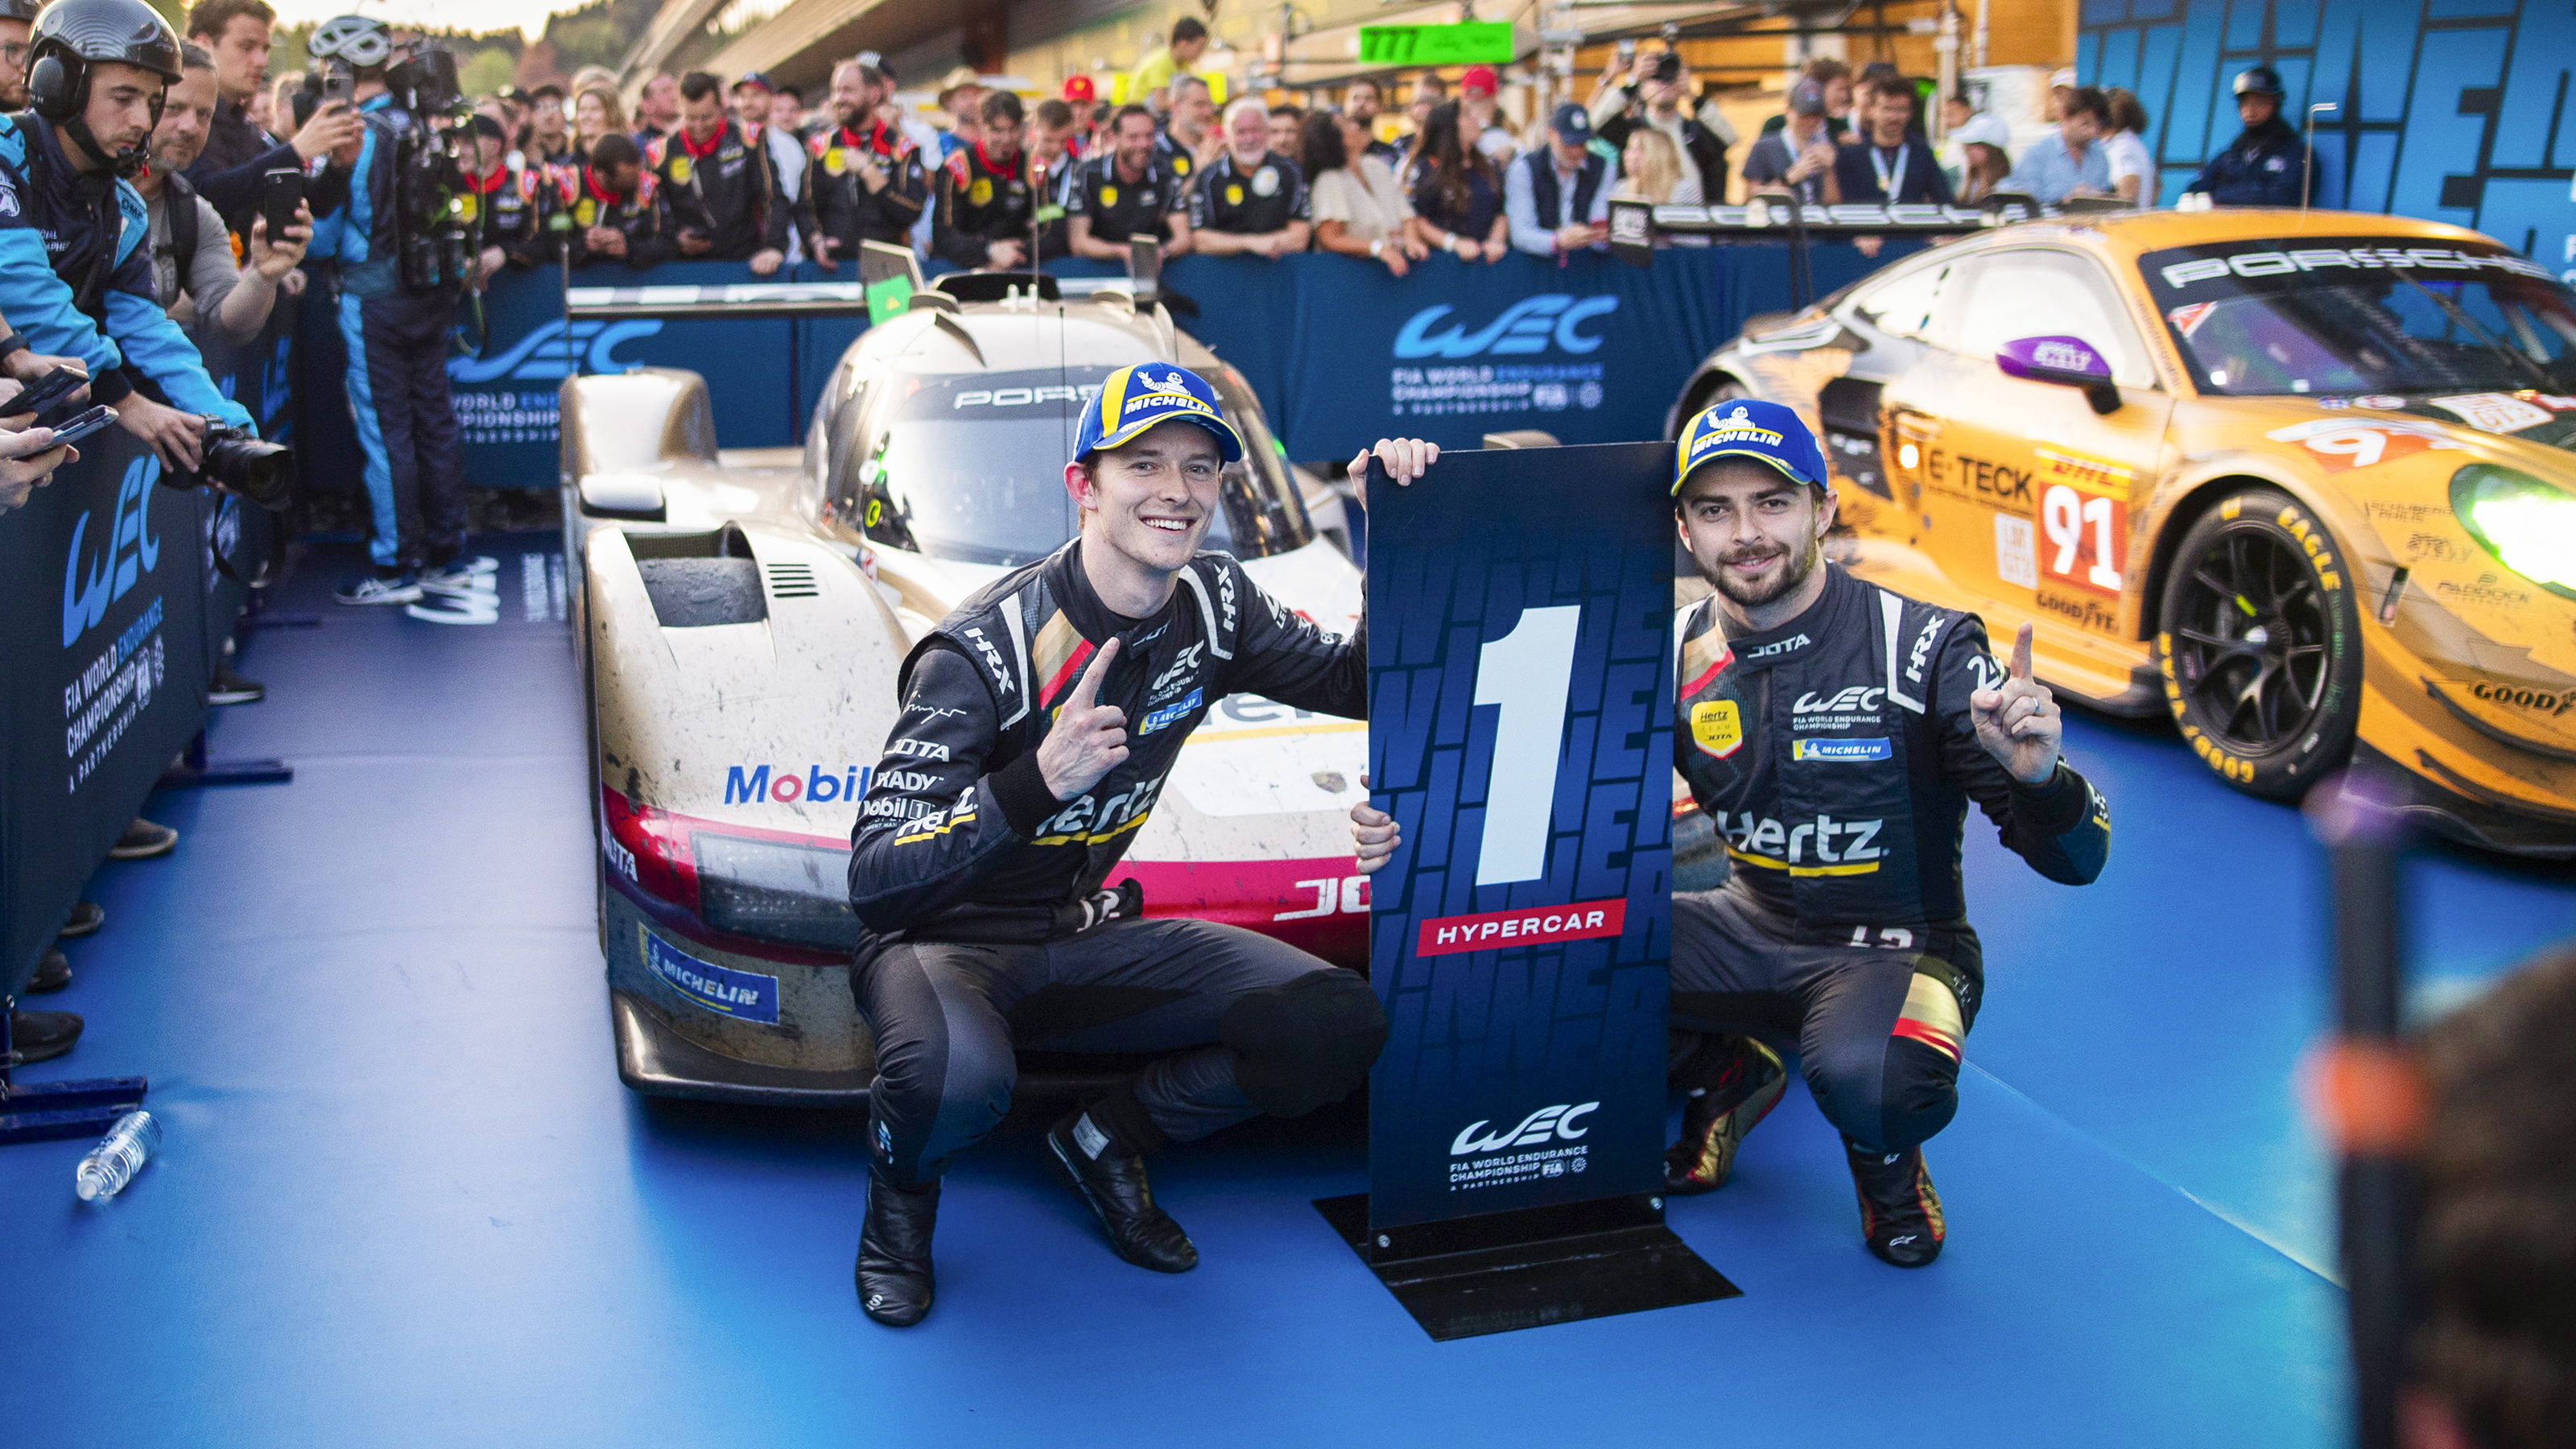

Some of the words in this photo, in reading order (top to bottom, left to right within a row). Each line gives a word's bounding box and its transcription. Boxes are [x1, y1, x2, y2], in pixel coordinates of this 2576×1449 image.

[1366, 27, 1419, 62] 777
[121, 199, 143, 221] OMP
[2161, 248, 2560, 290] PORSCHE
[1392, 292, 1620, 359] WEC
[953, 383, 1101, 410] PORS
[1125, 395, 1214, 415] MICHELIN
[1691, 430, 1783, 457] MICHELIN
[62, 452, 161, 649] WEC
[2043, 485, 2122, 592] 91
[2277, 506, 2343, 592] EAGLE
[964, 626, 1016, 696] HRX
[1747, 633, 1811, 659] JOTA
[1905, 613, 1946, 684] HRX
[64, 678, 82, 720] FIA
[82, 642, 118, 700] WORLD
[66, 660, 138, 759] CHAMPIONSHIP
[1700, 711, 1728, 722] Hertz
[1793, 686, 1886, 714] WEC
[1794, 716, 1807, 724] FIA
[1808, 716, 1833, 724] WORLD
[1834, 715, 1882, 724] ENDURANCE
[1794, 722, 1852, 732] CHAMPIONSHIP
[884, 737, 950, 762] JOTA
[1473, 604, 1583, 887] 1
[1821, 745, 1882, 755] MICHELIN
[724, 764, 873, 806] Mobil
[877, 770, 937, 791] RADY
[1716, 810, 1884, 864] Hertz
[1437, 908, 1607, 945] HYPERCAR
[663, 957, 760, 1006] MICHELIN
[1450, 1100, 1600, 1156] WEC
[1450, 1162, 1469, 1173] FIA
[1472, 1155, 1515, 1170] WORLD
[1517, 1145, 1589, 1164] ENDURANCE
[1450, 1162, 1541, 1183] CHAMPIONSHIP
[1450, 1184, 1457, 1192] A
[1462, 1173, 1541, 1191] PARTNERSHIP
